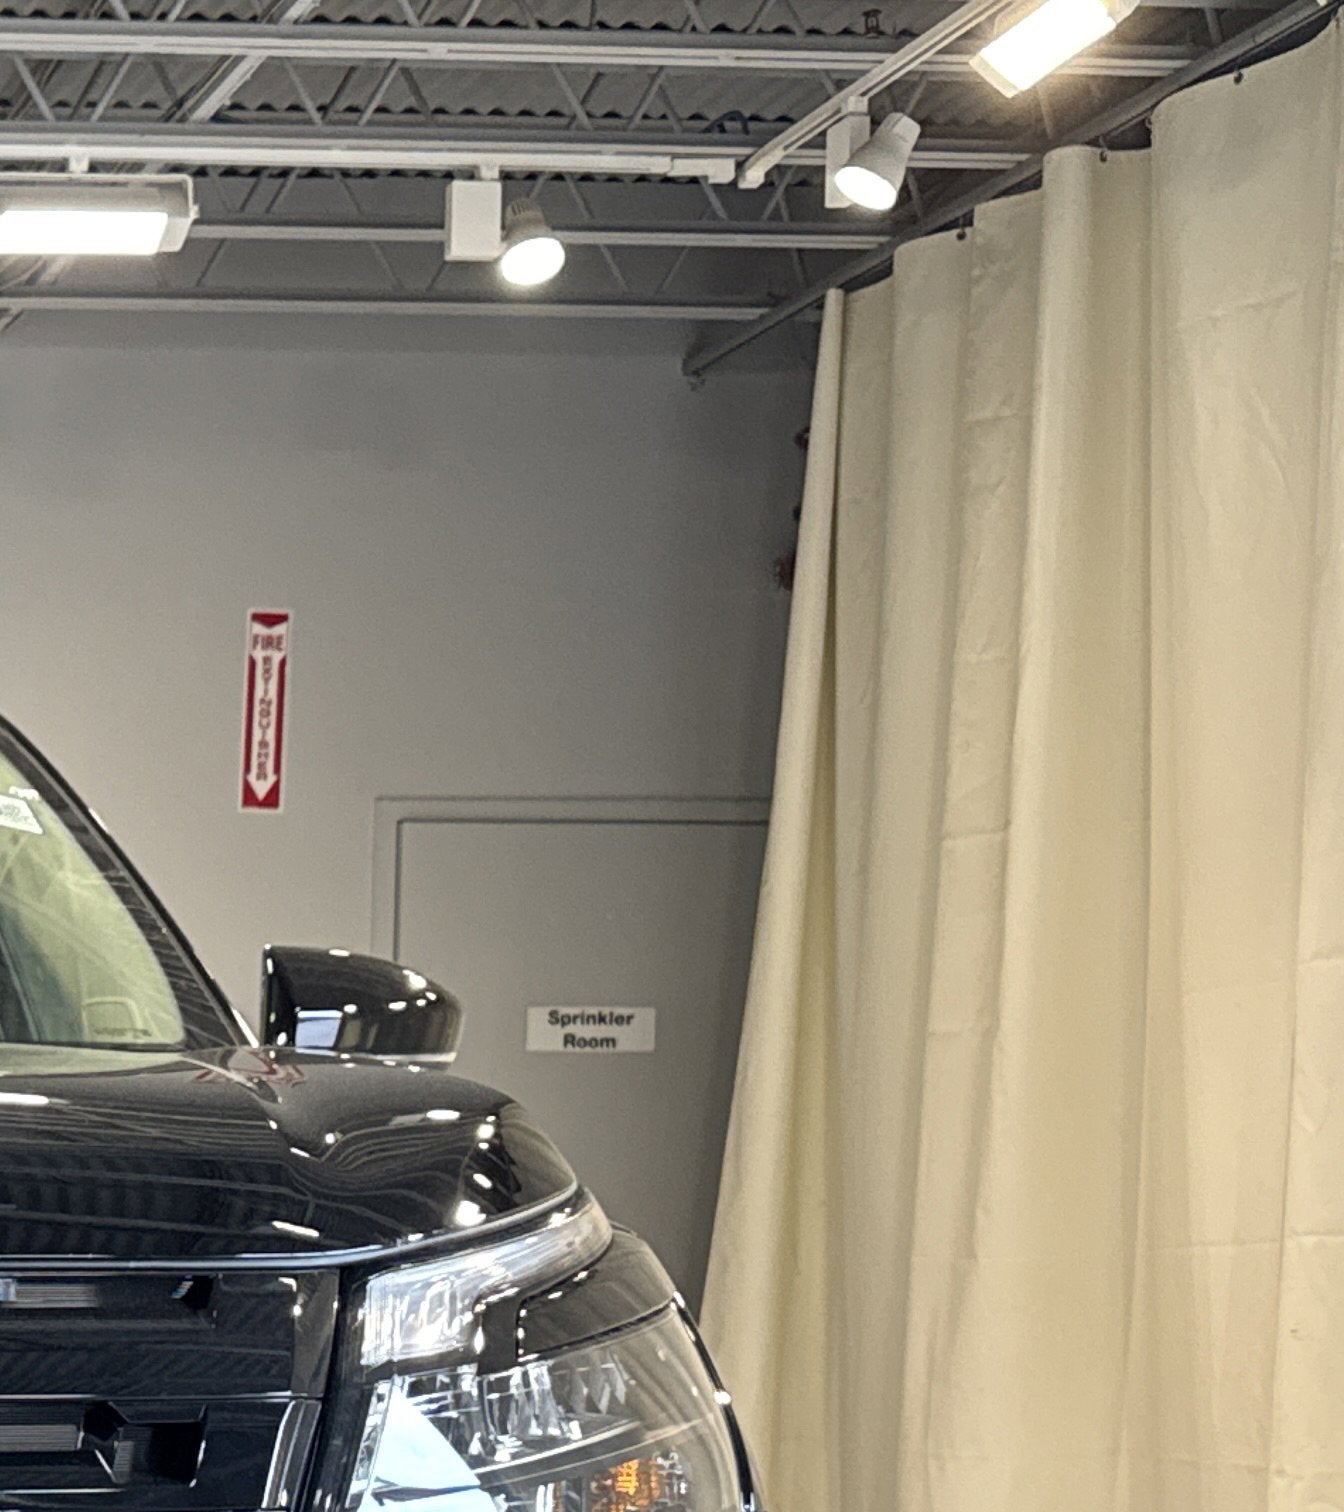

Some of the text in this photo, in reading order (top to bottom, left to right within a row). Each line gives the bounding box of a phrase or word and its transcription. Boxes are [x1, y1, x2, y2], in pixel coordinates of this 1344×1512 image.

[252, 633, 284, 652] FIRE
[547, 1009, 634, 1028] Sprinkler
[563, 1033, 617, 1049] Room
